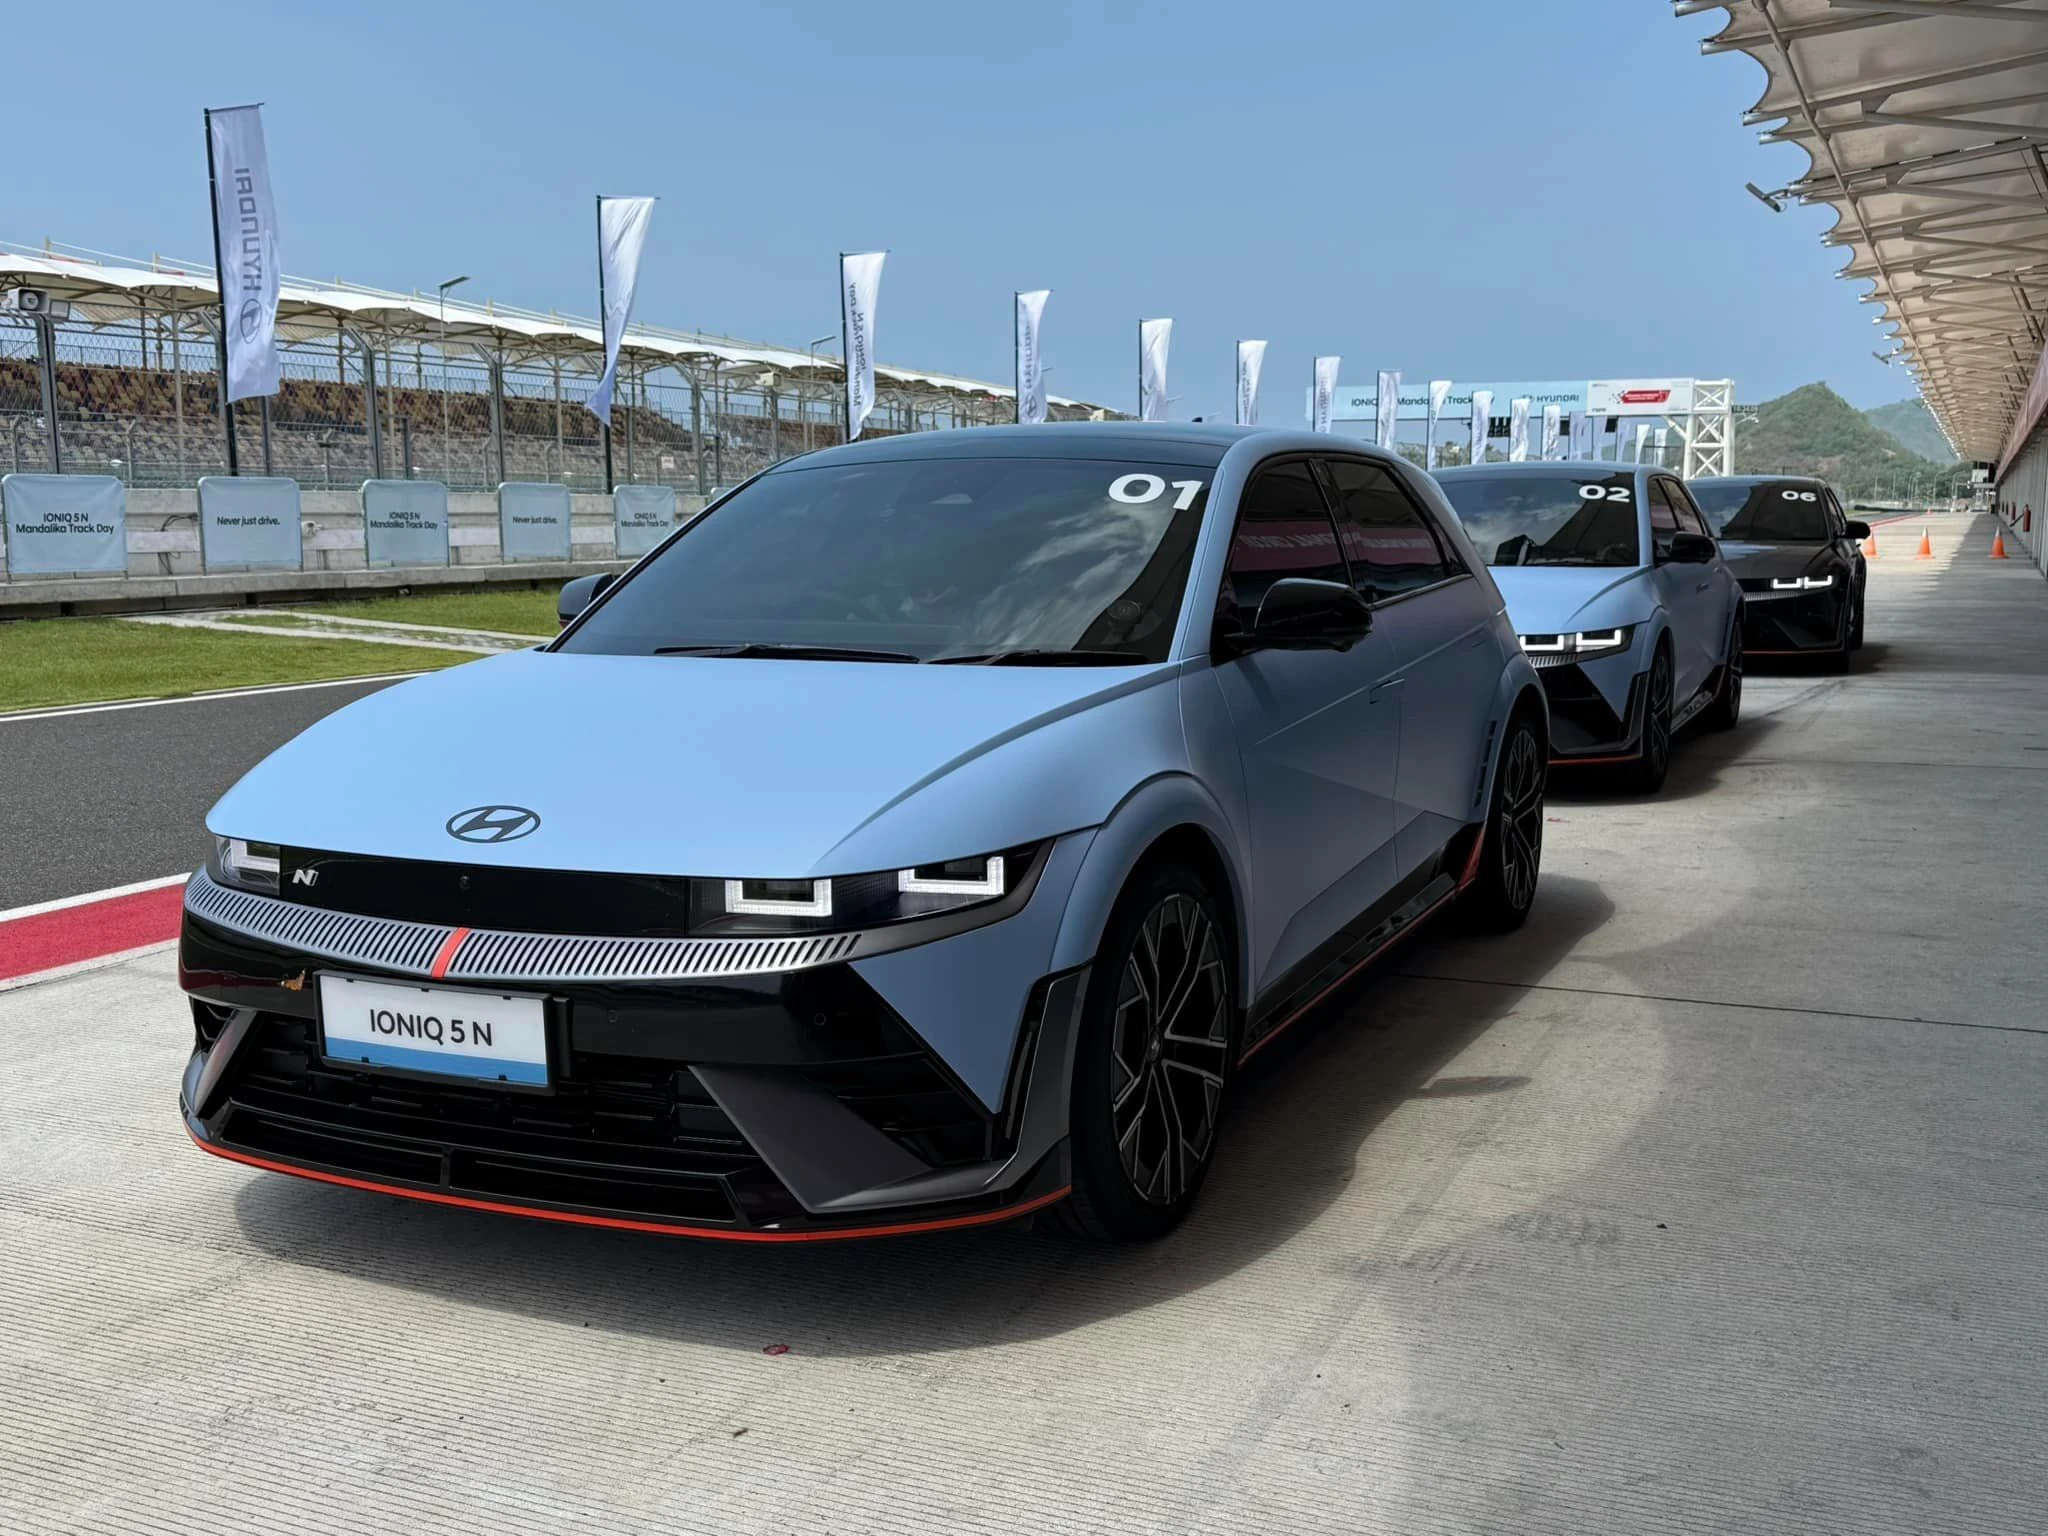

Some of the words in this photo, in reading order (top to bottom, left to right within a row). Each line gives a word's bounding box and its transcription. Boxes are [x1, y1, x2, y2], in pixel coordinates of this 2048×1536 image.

[1536, 394, 1580, 402] HYUNDAI
[1108, 473, 1203, 511] 01
[1578, 484, 1631, 503] 02
[1781, 490, 1817, 502] 06
[43, 513, 72, 523] IONIQ
[73, 513, 80, 522] 5
[80, 513, 89, 522] N
[217, 516, 241, 526] Never
[240, 515, 257, 527] just
[257, 515, 281, 526] drive.
[414, 512, 421, 520] N
[512, 516, 530, 524] Never
[16, 523, 67, 534] Mandalika
[67, 524, 95, 533] Track
[96, 523, 115, 535] Day
[424, 521, 438, 530] Day
[370, 1008, 444, 1045] IONIQ
[449, 1019, 466, 1044] 5
[472, 1021, 493, 1047] N
